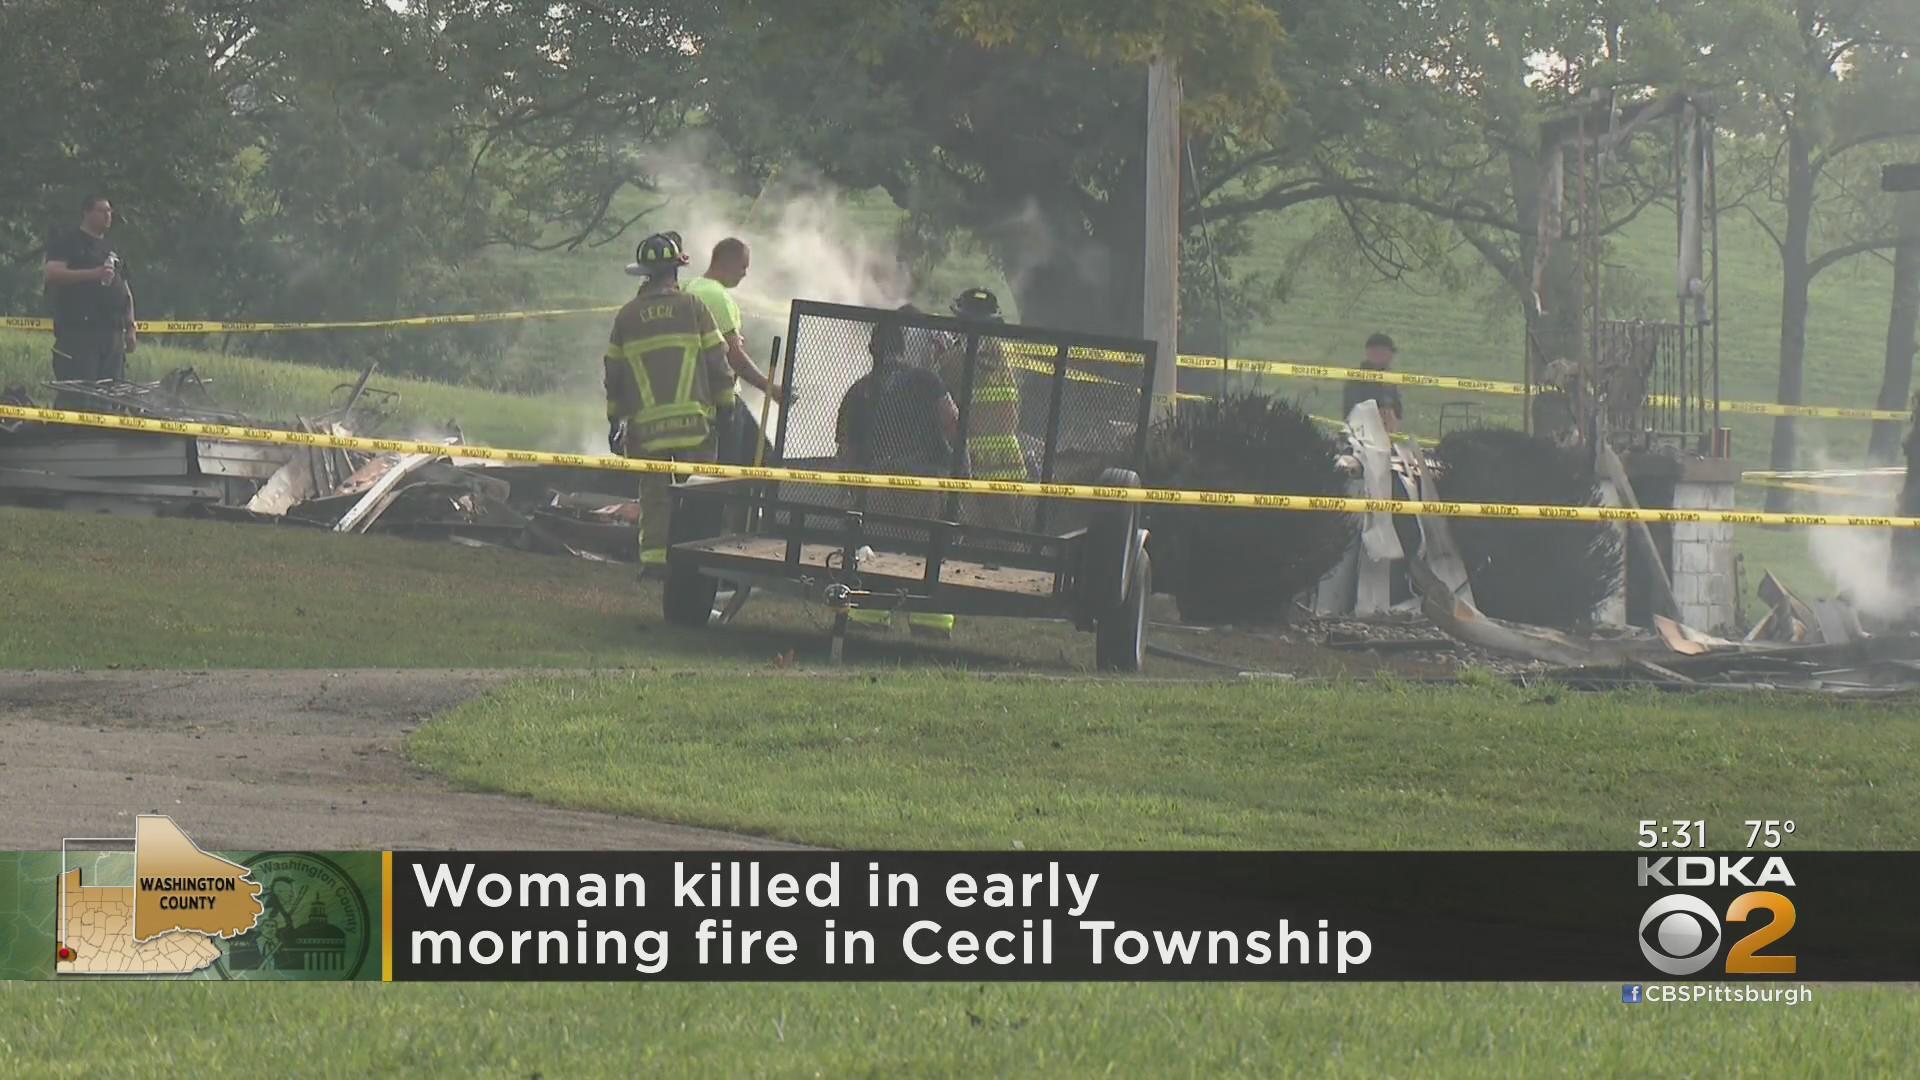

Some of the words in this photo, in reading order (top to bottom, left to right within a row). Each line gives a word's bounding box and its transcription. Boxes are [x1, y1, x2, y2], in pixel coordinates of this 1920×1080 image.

[6, 318, 41, 328] CAUTION
[167, 323, 203, 332] CAUTION
[1180, 358, 1217, 368] CAUTION
[1291, 366, 1329, 377] CAUTION
[1346, 369, 1384, 381] CAUTION
[1402, 374, 1440, 385] CAUTION
[1458, 379, 1496, 390] CAUTION
[1146, 490, 1182, 502] CAUTION
[1200, 493, 1236, 504] CAUTION
[1254, 496, 1290, 507] CAUTION
[1308, 498, 1346, 510] CAUTION
[1366, 502, 1403, 512] CAUTION
[1421, 503, 1461, 514] CAUTION
[1480, 504, 1520, 516] CAUTION
[1538, 507, 1578, 518] CAUTION
[1599, 509, 1639, 520] CAUTION
[1659, 512, 1700, 522] CAUTION
[1721, 514, 1763, 524] CAUTION
[1784, 516, 1826, 526] CAUTION
[1848, 518, 1891, 527] CAUTION
